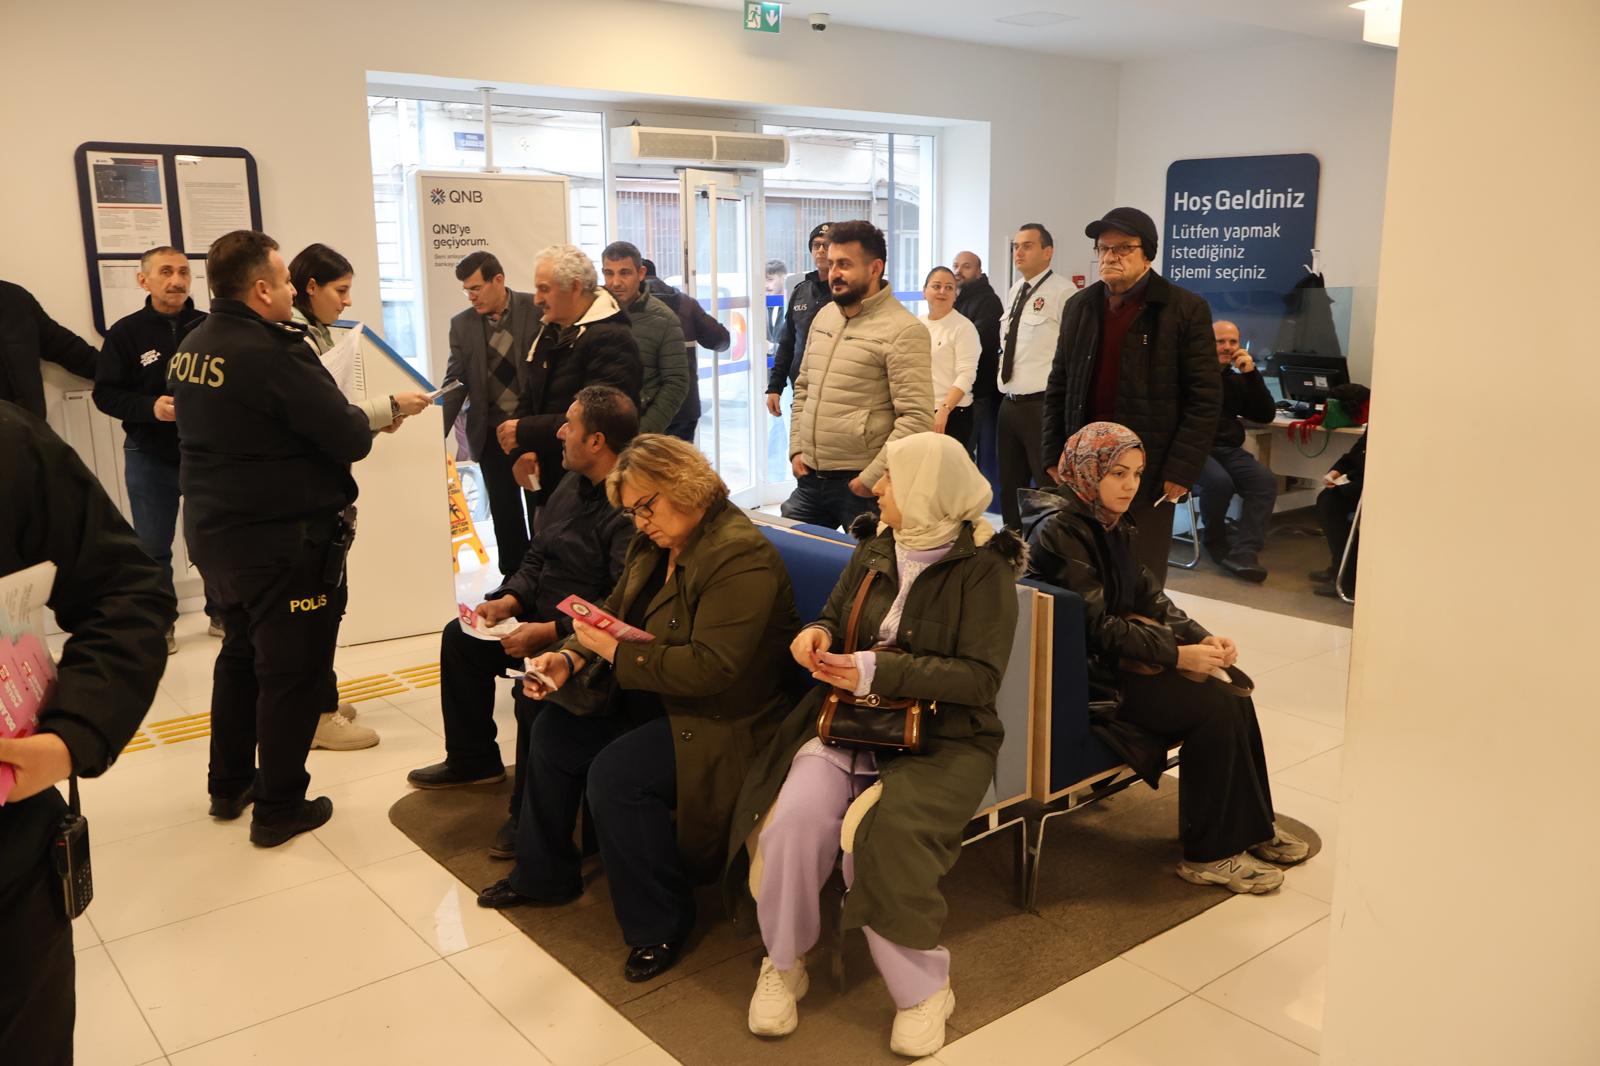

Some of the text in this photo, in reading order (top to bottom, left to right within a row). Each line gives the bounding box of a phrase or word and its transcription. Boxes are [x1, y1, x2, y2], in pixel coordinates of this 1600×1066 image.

[449, 190, 483, 203] QNB
[1174, 188, 1305, 215] Hoş Geldiniz
[432, 224, 471, 236] QNB'ye
[1172, 222, 1281, 241] Lütfen yapmak
[433, 237, 489, 249] geçiyorum.
[1171, 244, 1245, 262] istediğiniz
[1170, 264, 1211, 281] işlemi
